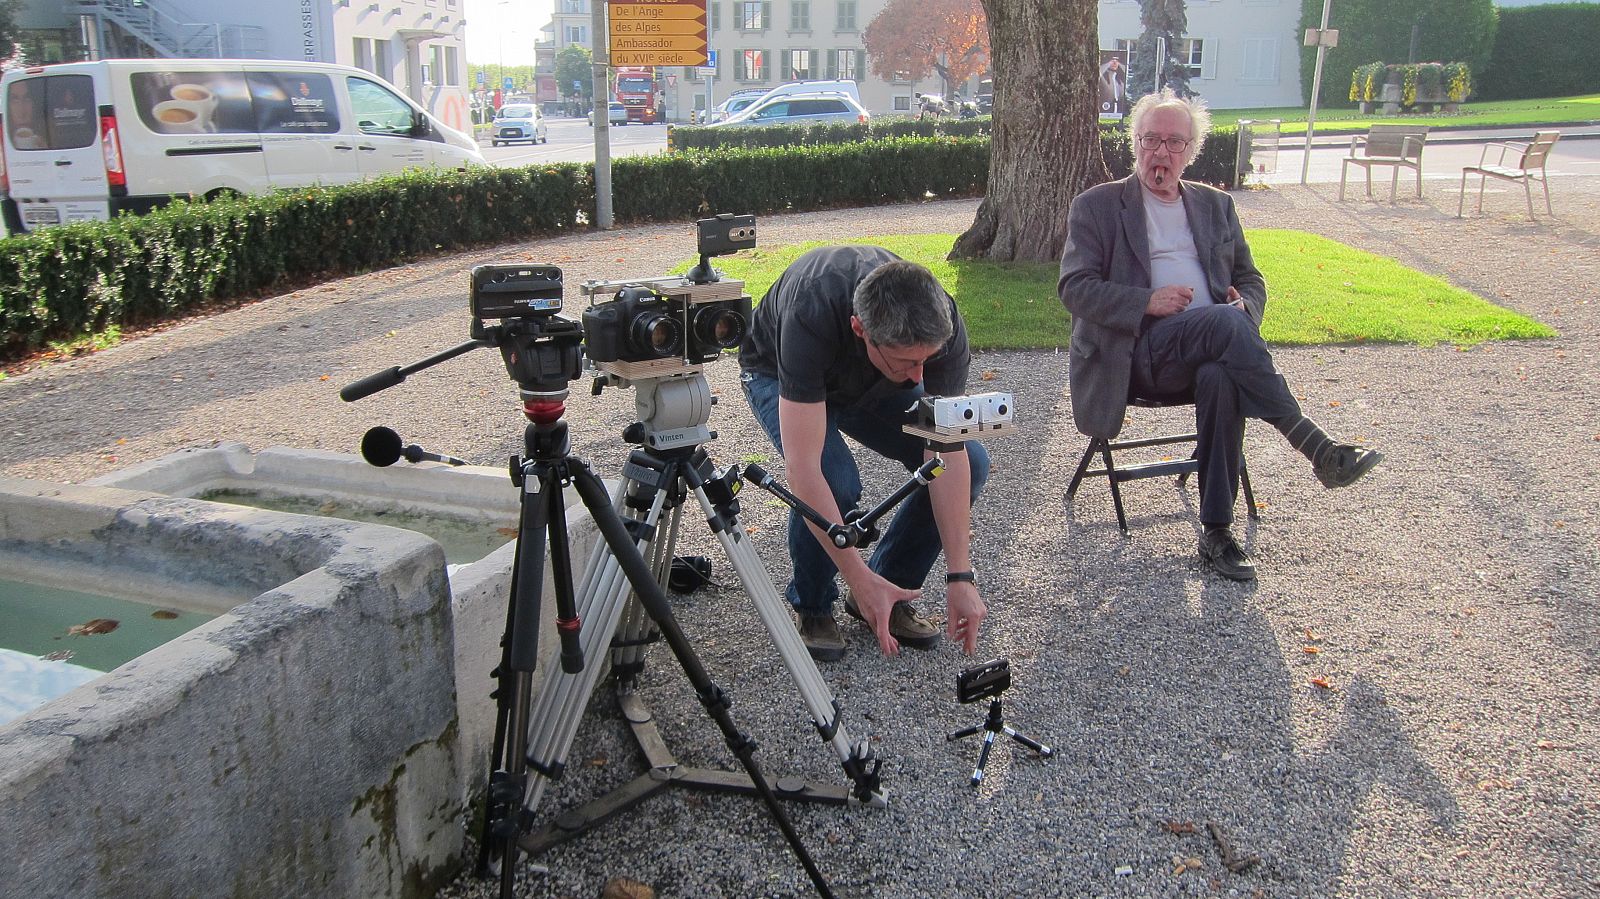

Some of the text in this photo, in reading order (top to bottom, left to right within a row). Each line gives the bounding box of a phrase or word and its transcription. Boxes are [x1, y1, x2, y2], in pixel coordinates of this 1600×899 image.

[616, 7, 663, 18] De l'Ange
[616, 22, 661, 33] des Alpes
[617, 38, 673, 48] Ambassador
[617, 54, 628, 63] du
[659, 433, 684, 442] Vinten
